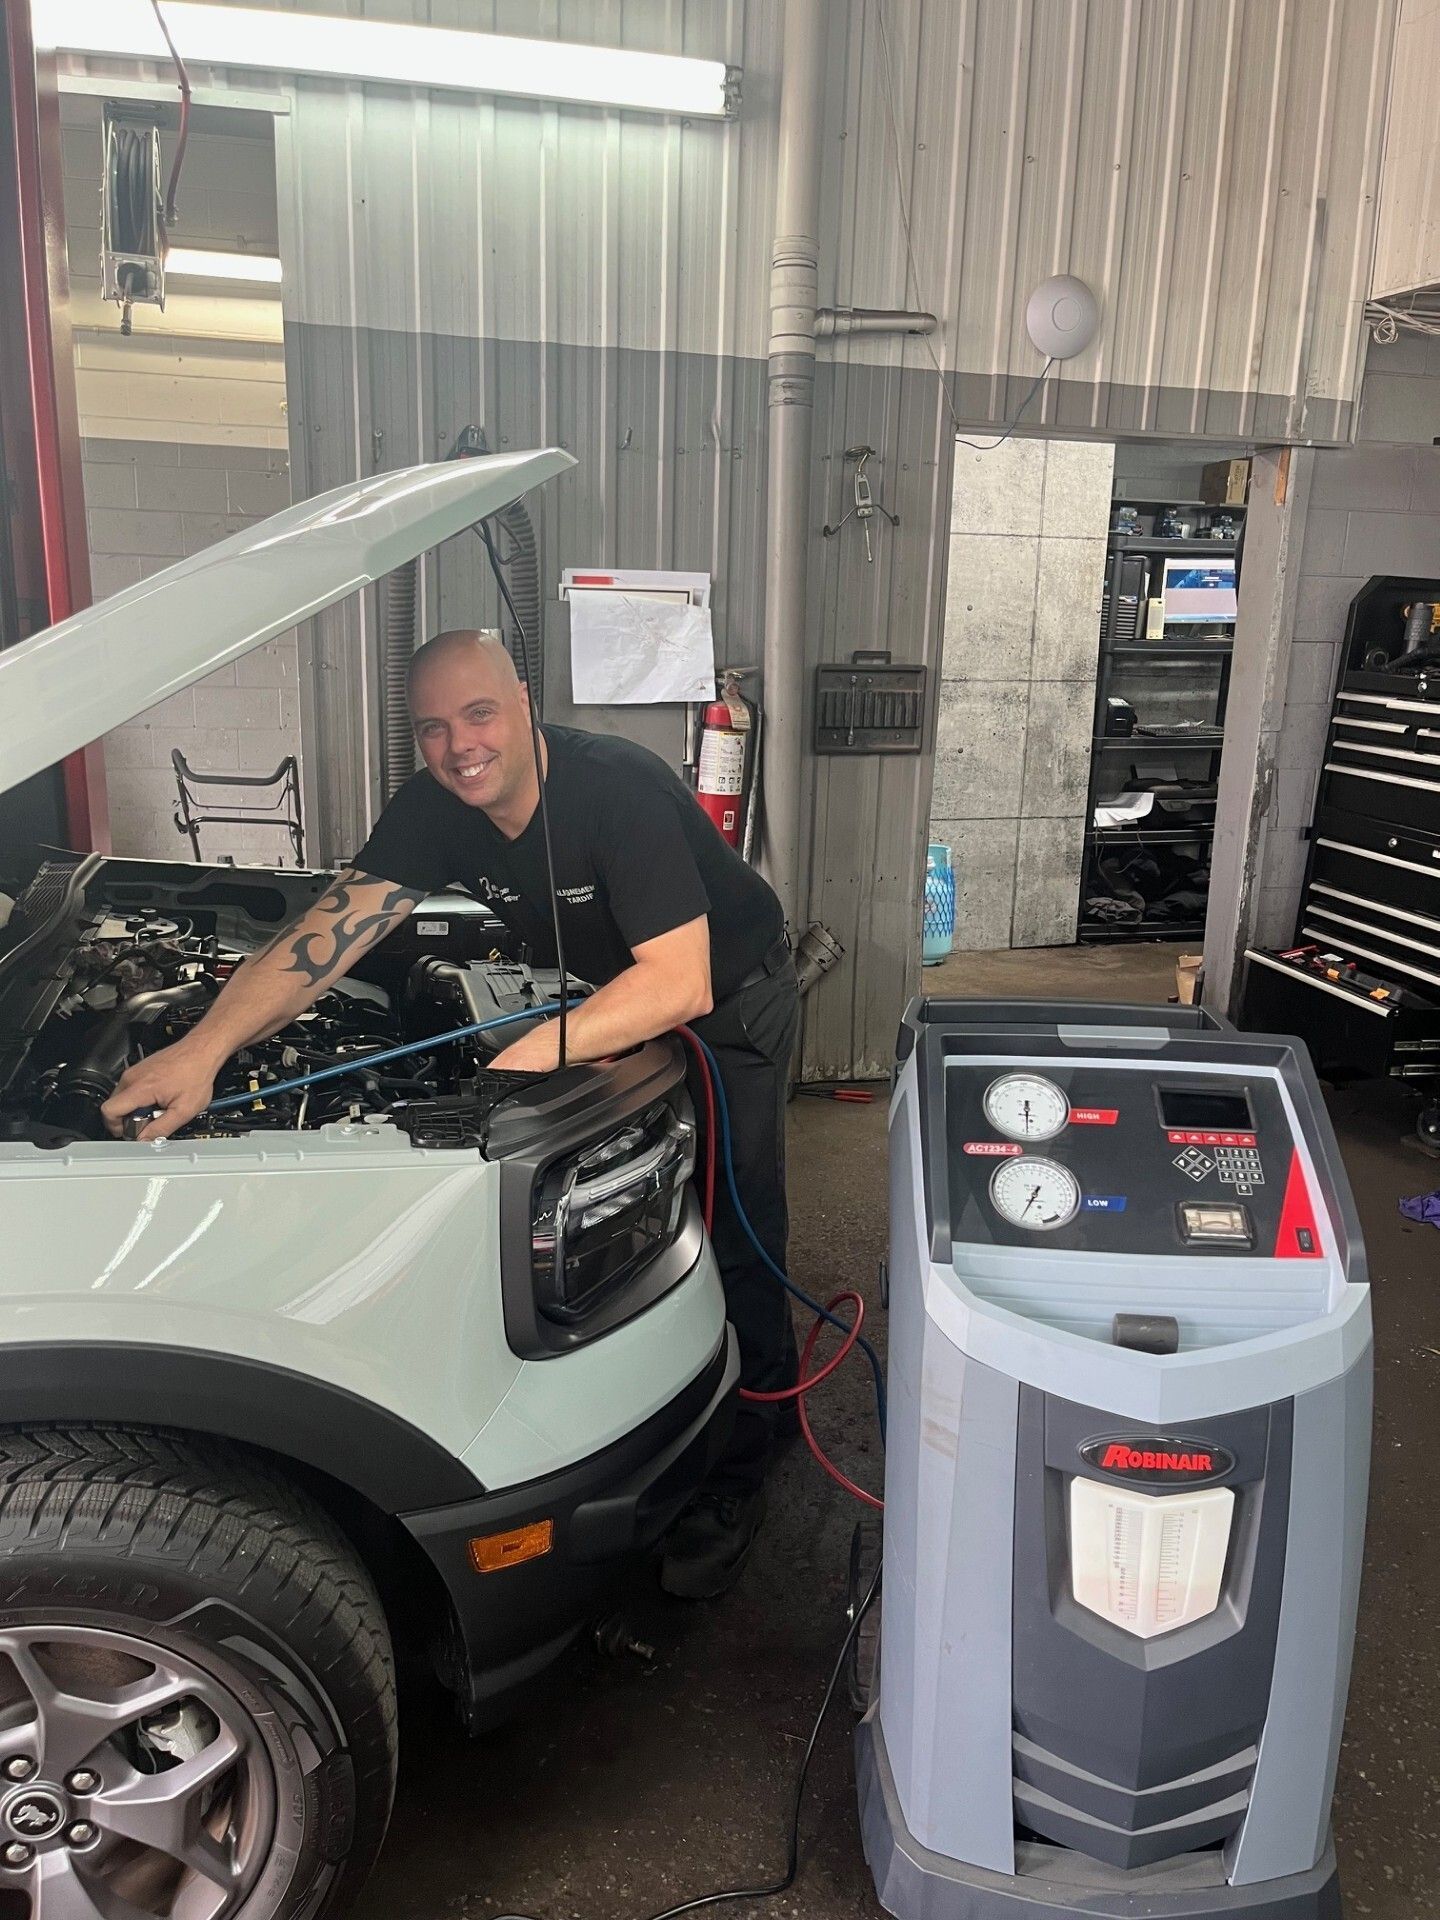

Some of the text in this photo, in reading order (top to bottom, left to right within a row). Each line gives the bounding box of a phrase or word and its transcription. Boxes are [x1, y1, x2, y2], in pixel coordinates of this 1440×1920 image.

[566, 892, 594, 904] TARDIF
[1076, 1112, 1100, 1121] HIGH
[968, 1144, 1018, 1154] AC1234-4
[1087, 1199, 1109, 1207] LOW
[1101, 1444, 1213, 1471] ROBINAIR
